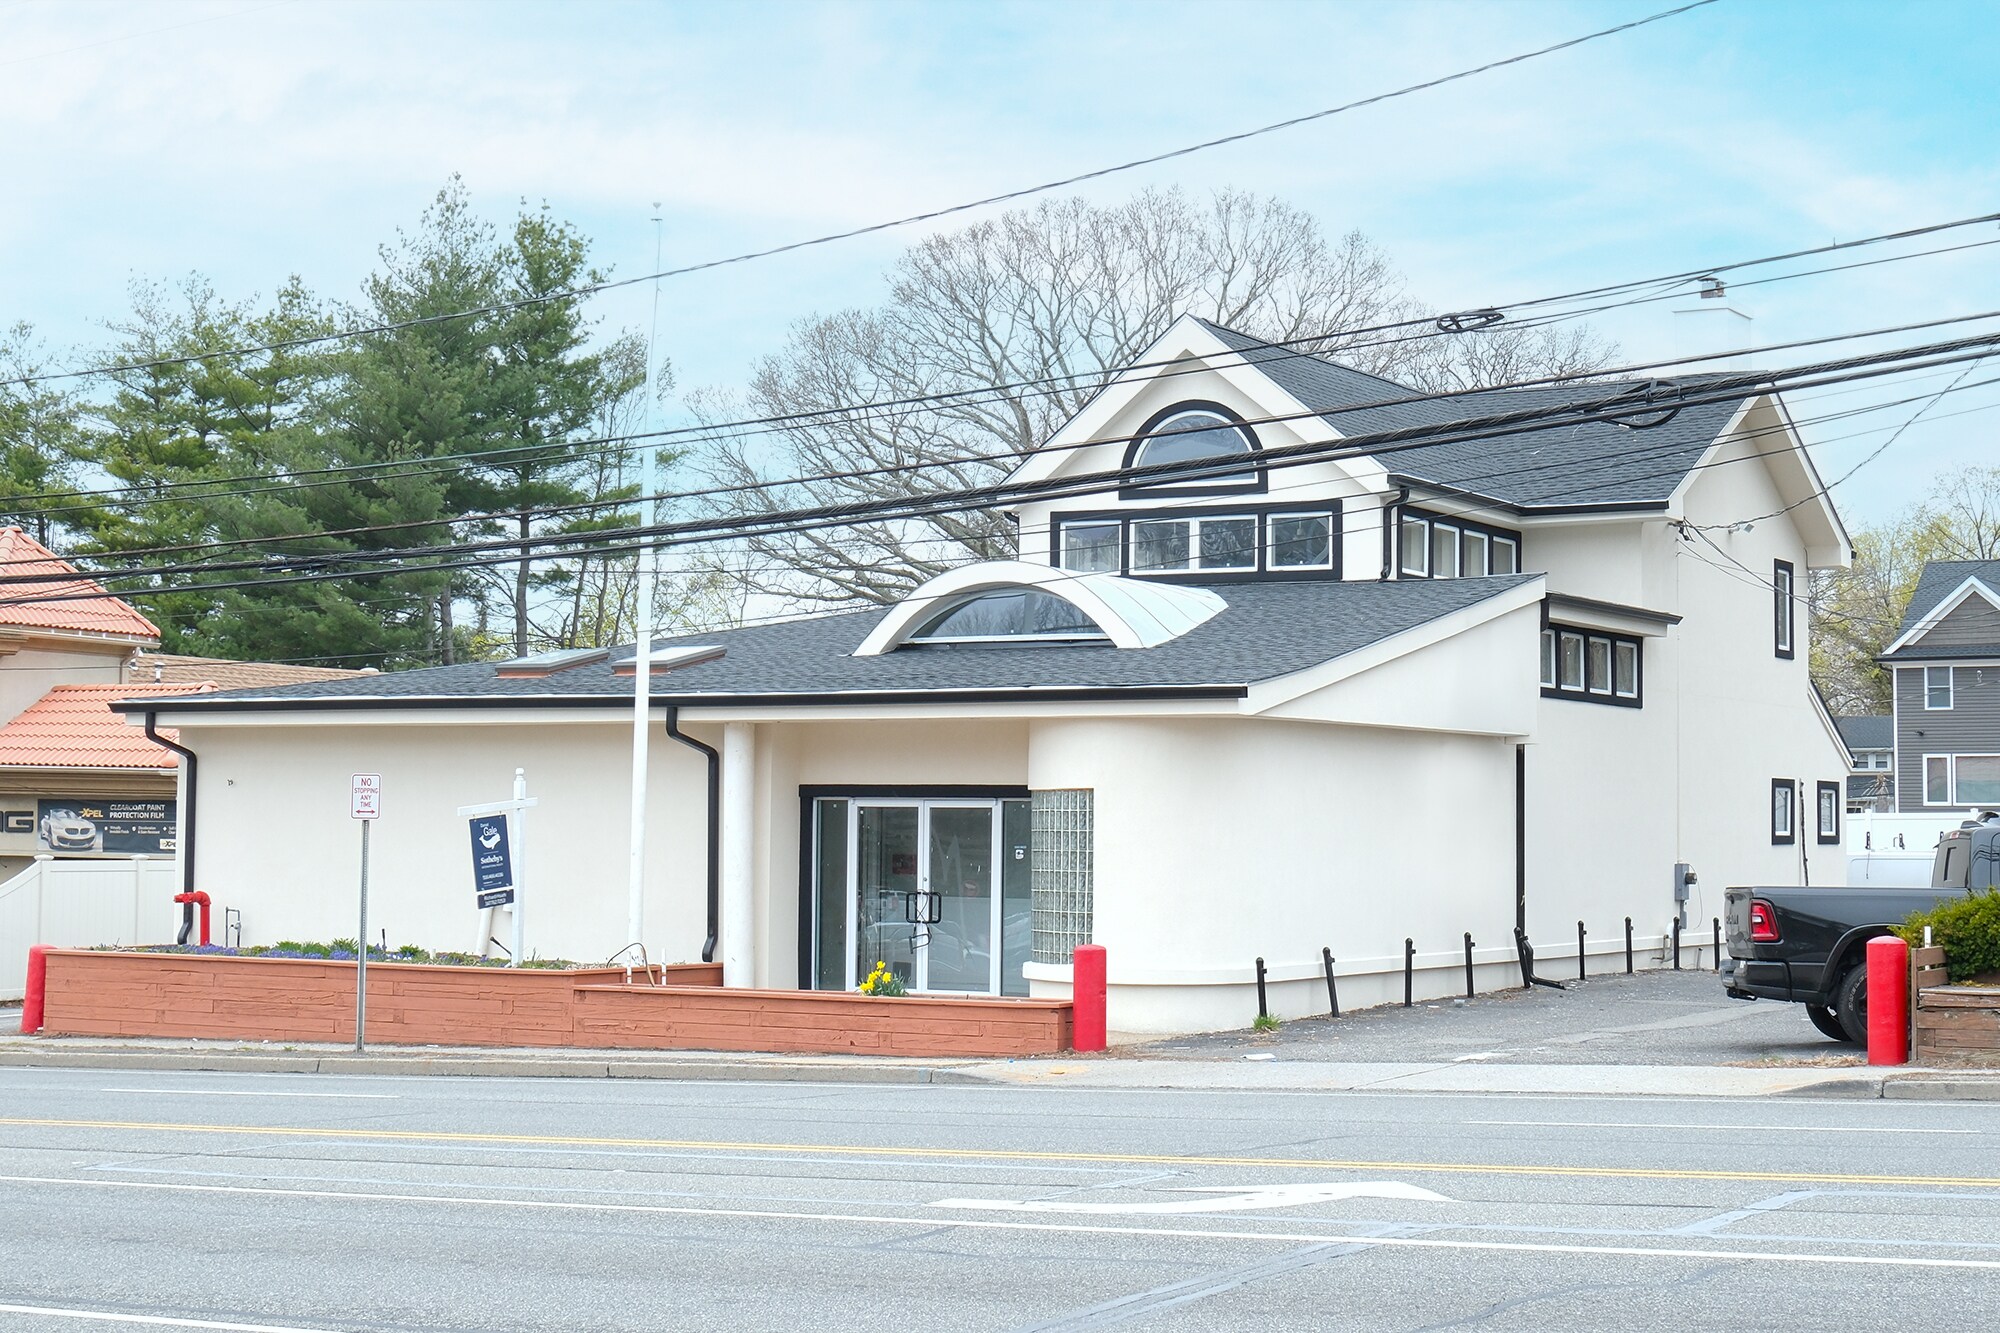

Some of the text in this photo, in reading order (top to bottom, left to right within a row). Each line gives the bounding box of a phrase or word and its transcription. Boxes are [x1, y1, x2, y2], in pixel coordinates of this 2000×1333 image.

[361, 778, 372, 786] NO
[81, 807, 104, 818] XPEL
[0, 811, 34, 833] G
[483, 826, 497, 836] Gale
[480, 854, 503, 864] Sotheby's
